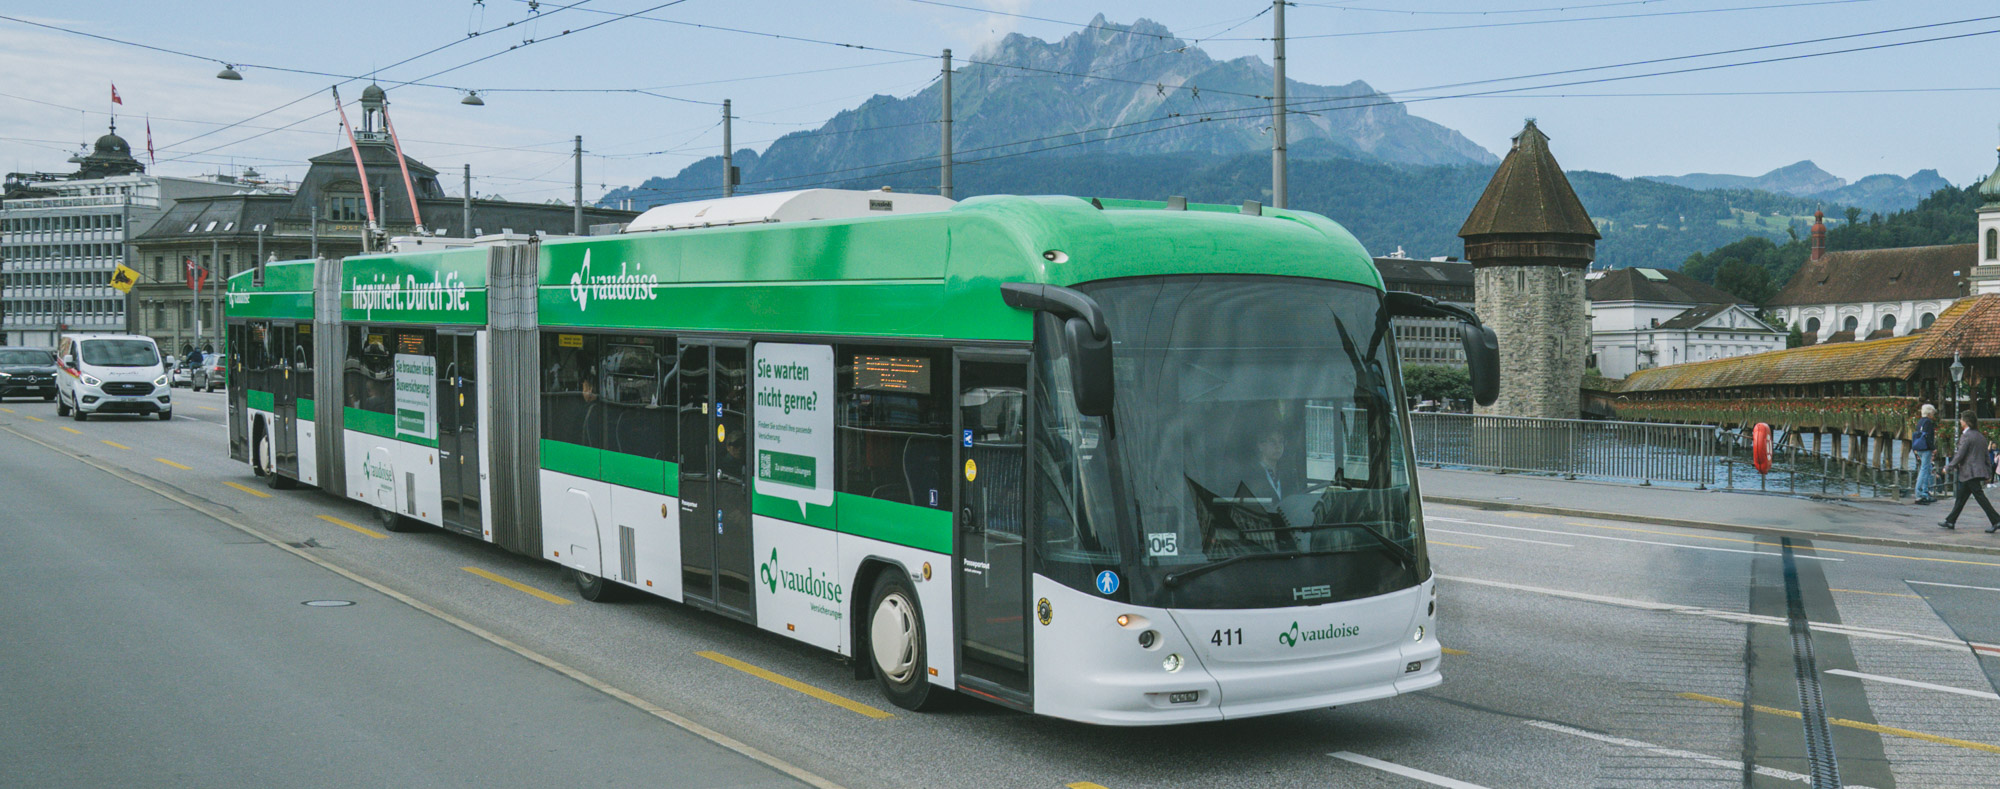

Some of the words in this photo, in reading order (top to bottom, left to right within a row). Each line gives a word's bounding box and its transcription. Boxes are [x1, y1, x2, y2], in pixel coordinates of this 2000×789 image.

[591, 262, 658, 301] vaudoise
[353, 274, 404, 321] Inspiriert.
[406, 270, 442, 311] Durch
[446, 270, 470, 311] Sie.
[757, 357, 772, 379] Sie
[774, 361, 809, 381] warten
[758, 386, 782, 408] nicht
[784, 390, 818, 415] gerne?
[1151, 537, 1176, 553] 05
[780, 567, 843, 604] vaudoise
[1293, 585, 1331, 600] HESS
[1211, 627, 1243, 646] 411
[1301, 622, 1360, 642] vaudoise
